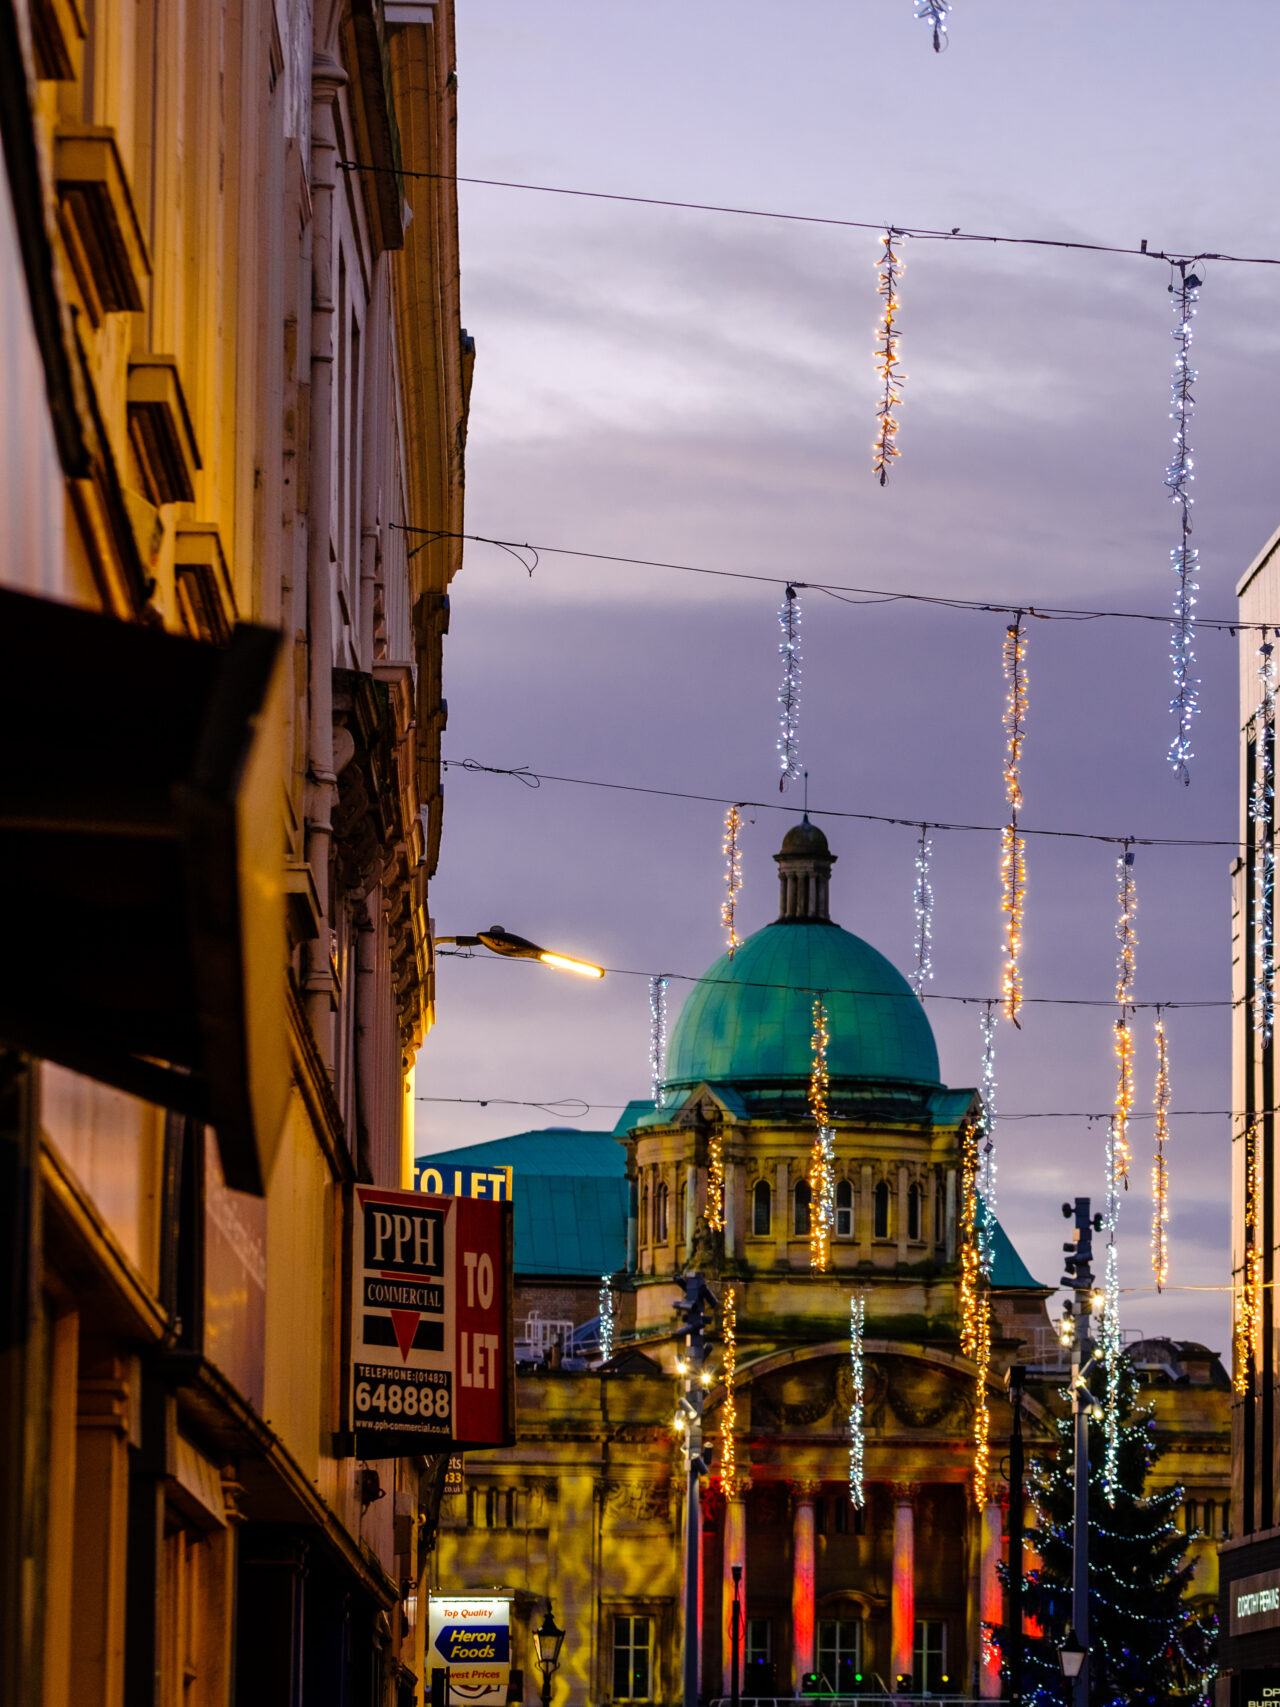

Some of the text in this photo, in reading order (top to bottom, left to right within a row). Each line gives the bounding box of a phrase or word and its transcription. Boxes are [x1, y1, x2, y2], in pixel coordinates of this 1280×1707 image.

[372, 1211, 437, 1266] PPH
[463, 1252, 494, 1310] TO
[368, 1283, 441, 1307] COMMERCIAL
[461, 1331, 499, 1389] LET
[355, 1381, 450, 1418] 648888
[355, 1420, 451, 1434] www.pph-commercial.co.uk
[444, 1609, 493, 1619] Top Quality
[450, 1630, 496, 1643] Heron
[450, 1645, 496, 1658] Foods
[449, 1670, 500, 1679] west Prices
